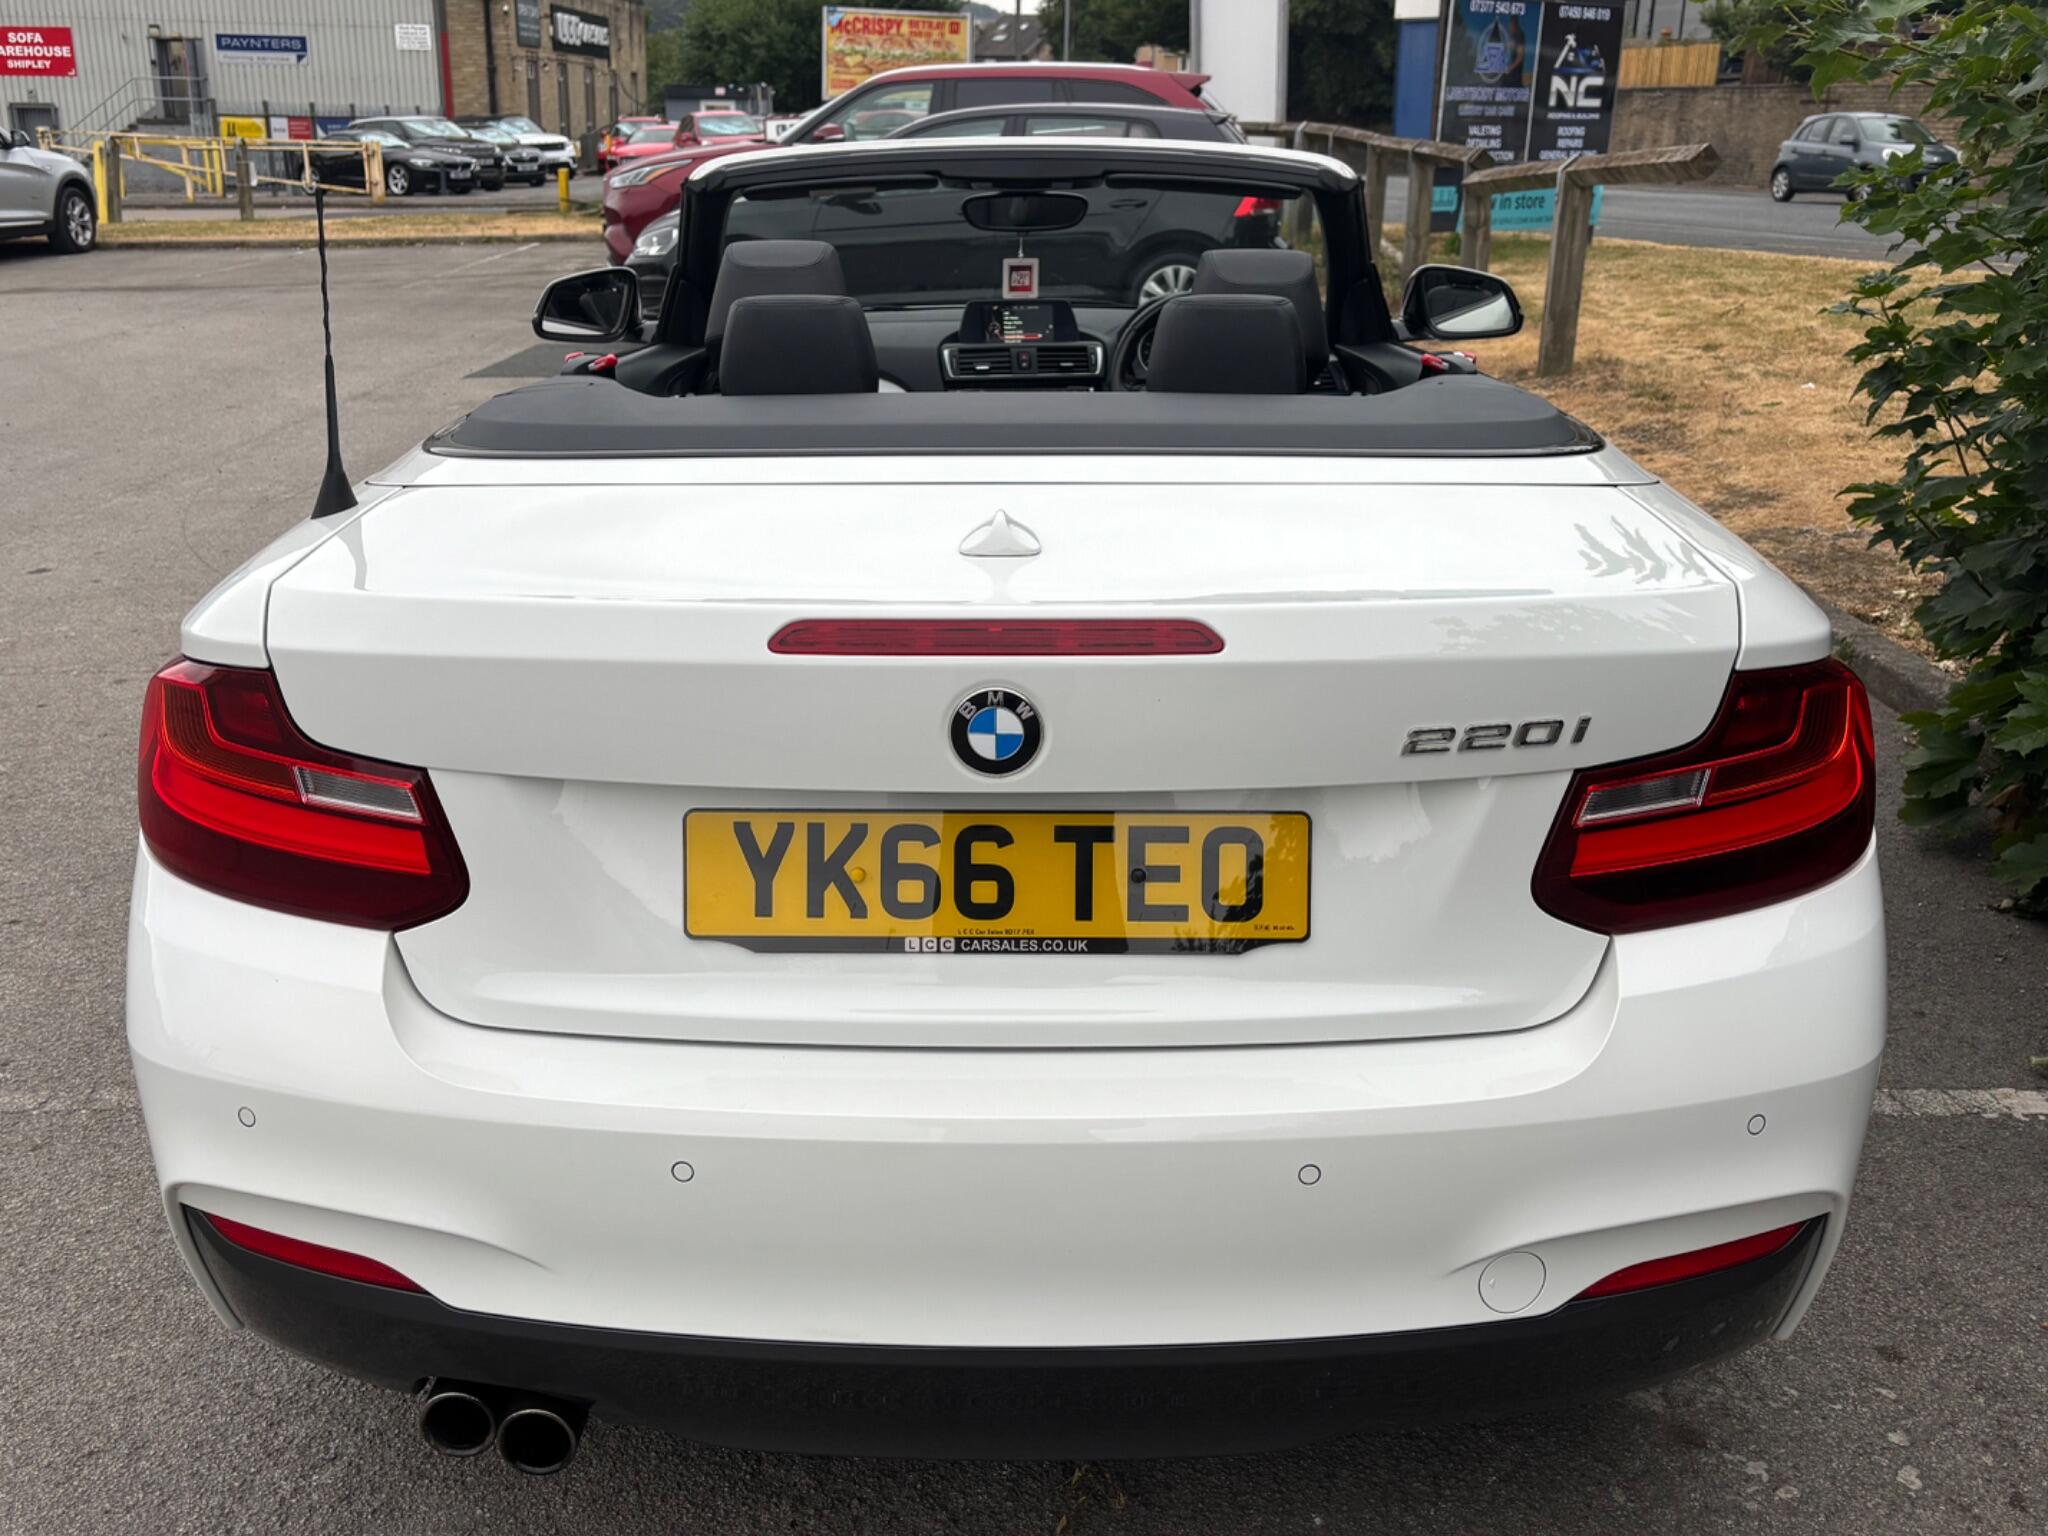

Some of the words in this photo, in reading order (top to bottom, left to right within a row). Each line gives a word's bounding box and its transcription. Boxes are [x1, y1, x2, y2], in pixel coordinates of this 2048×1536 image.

[7, 32, 44, 44] SOFA
[220, 36, 302, 50] PAYNTERS
[6, 59, 52, 69] SHIPLEY
[1548, 75, 1604, 108] NC
[1468, 125, 1502, 136] VALETING
[1557, 126, 1585, 136] ROOFING
[1556, 138, 1583, 148] REPAIRS
[1500, 193, 1513, 210] in
[1514, 194, 1545, 209] store
[958, 691, 1035, 720] BMW
[732, 820, 1016, 921] YK66
[1053, 824, 1265, 922] TEO
[960, 939, 1089, 952] CARSALES.CO.UK
